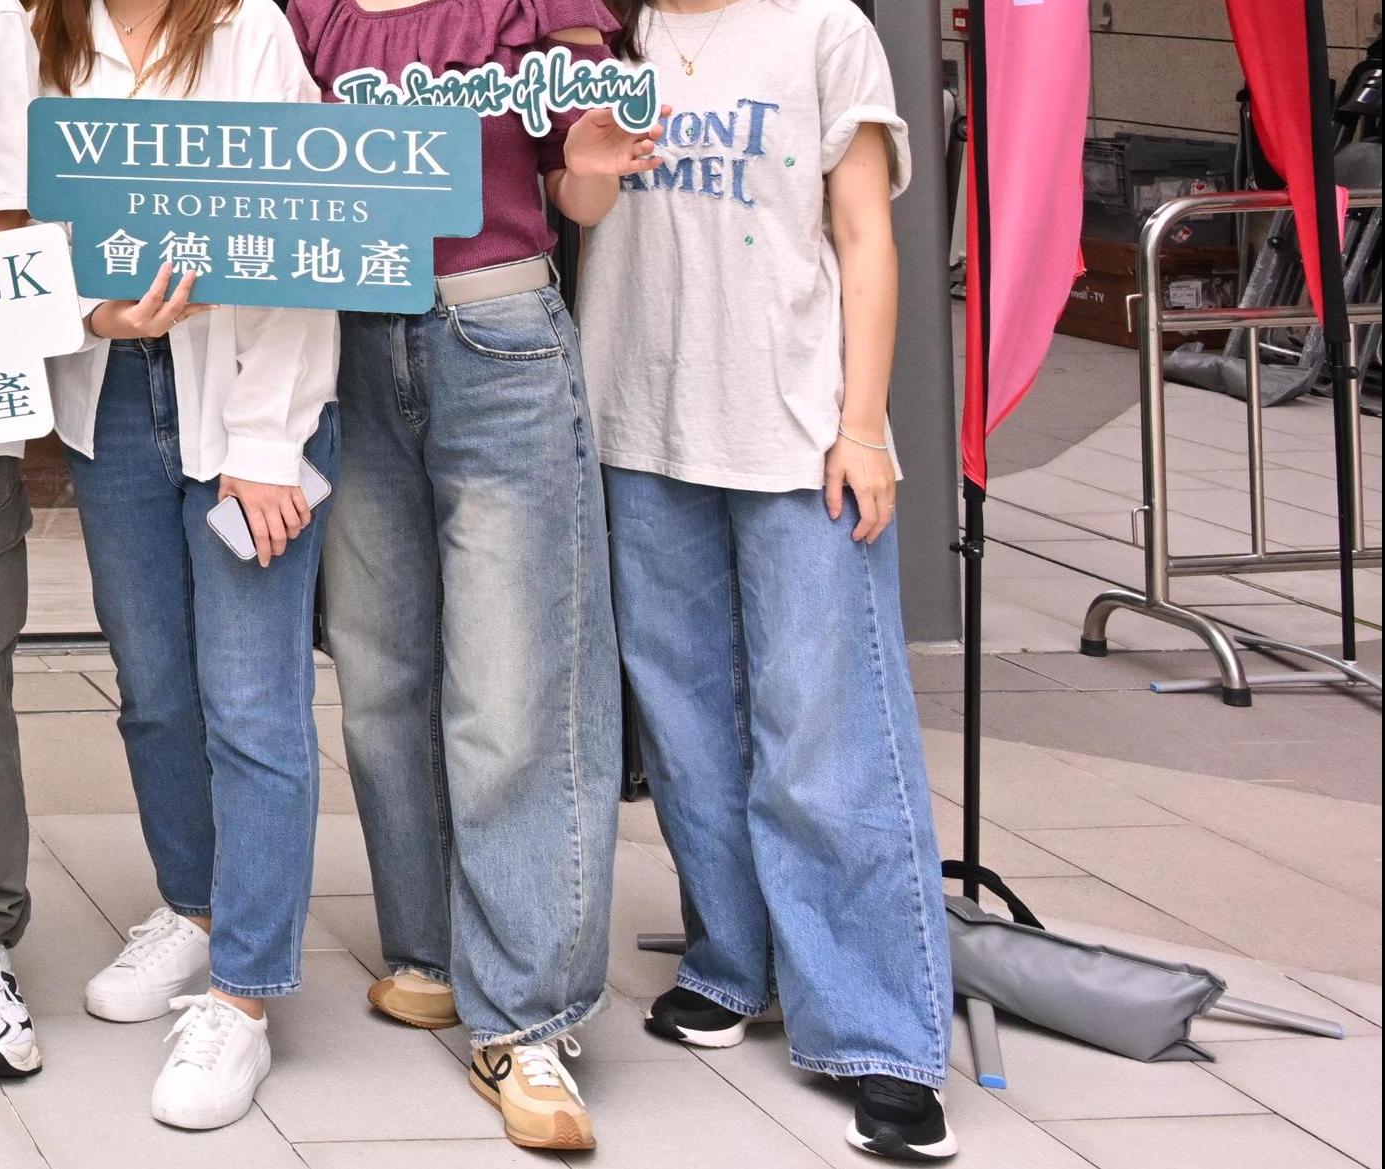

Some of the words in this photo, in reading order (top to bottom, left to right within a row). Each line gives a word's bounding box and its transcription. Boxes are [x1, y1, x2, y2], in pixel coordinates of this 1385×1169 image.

[341, 77, 396, 105] The
[405, 68, 510, 111] Spirit
[514, 58, 546, 131] of
[550, 52, 655, 126] Living
[55, 120, 450, 176] WHEELOCK
[128, 192, 368, 223] PROPERTIES
[96, 228, 412, 287] 會德豐地產
